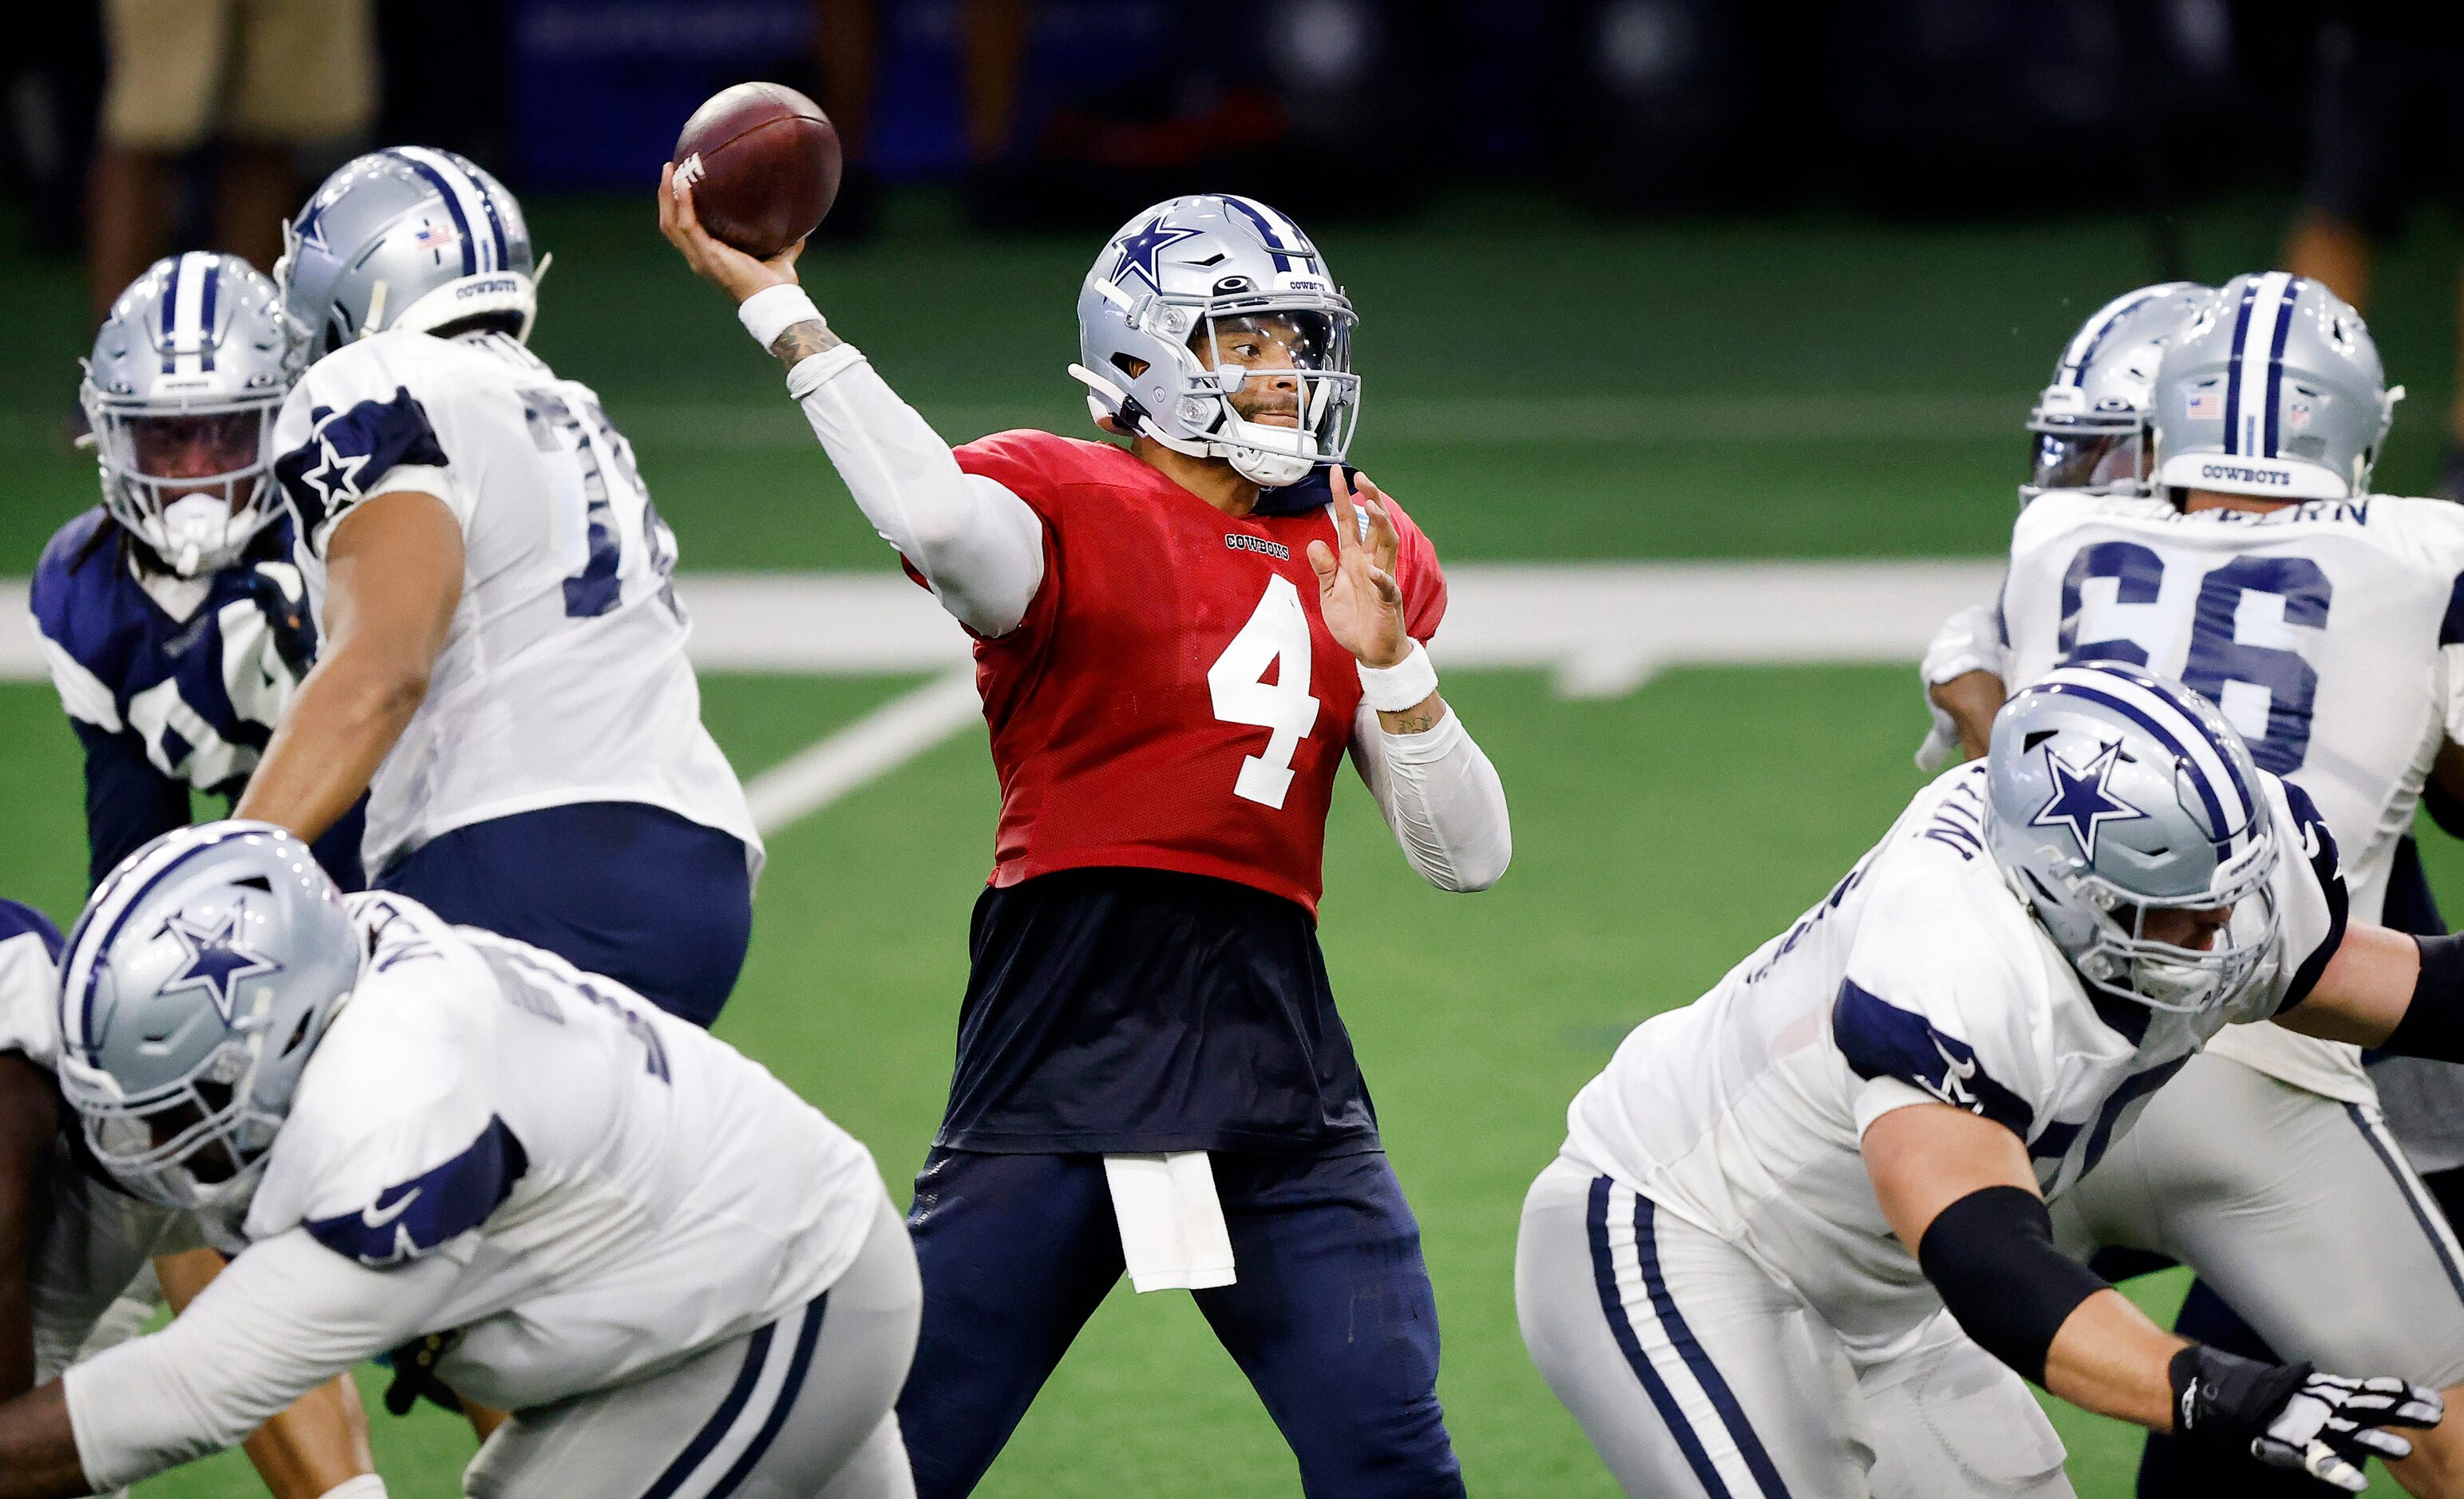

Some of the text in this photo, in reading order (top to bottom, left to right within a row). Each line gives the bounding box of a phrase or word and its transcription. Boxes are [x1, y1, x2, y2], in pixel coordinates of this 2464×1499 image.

[2203, 465, 2290, 485] COWBOYS
[1224, 534, 1290, 561] COWBOYS
[1207, 572, 1320, 810] 4
[2059, 541, 2332, 777] 66
